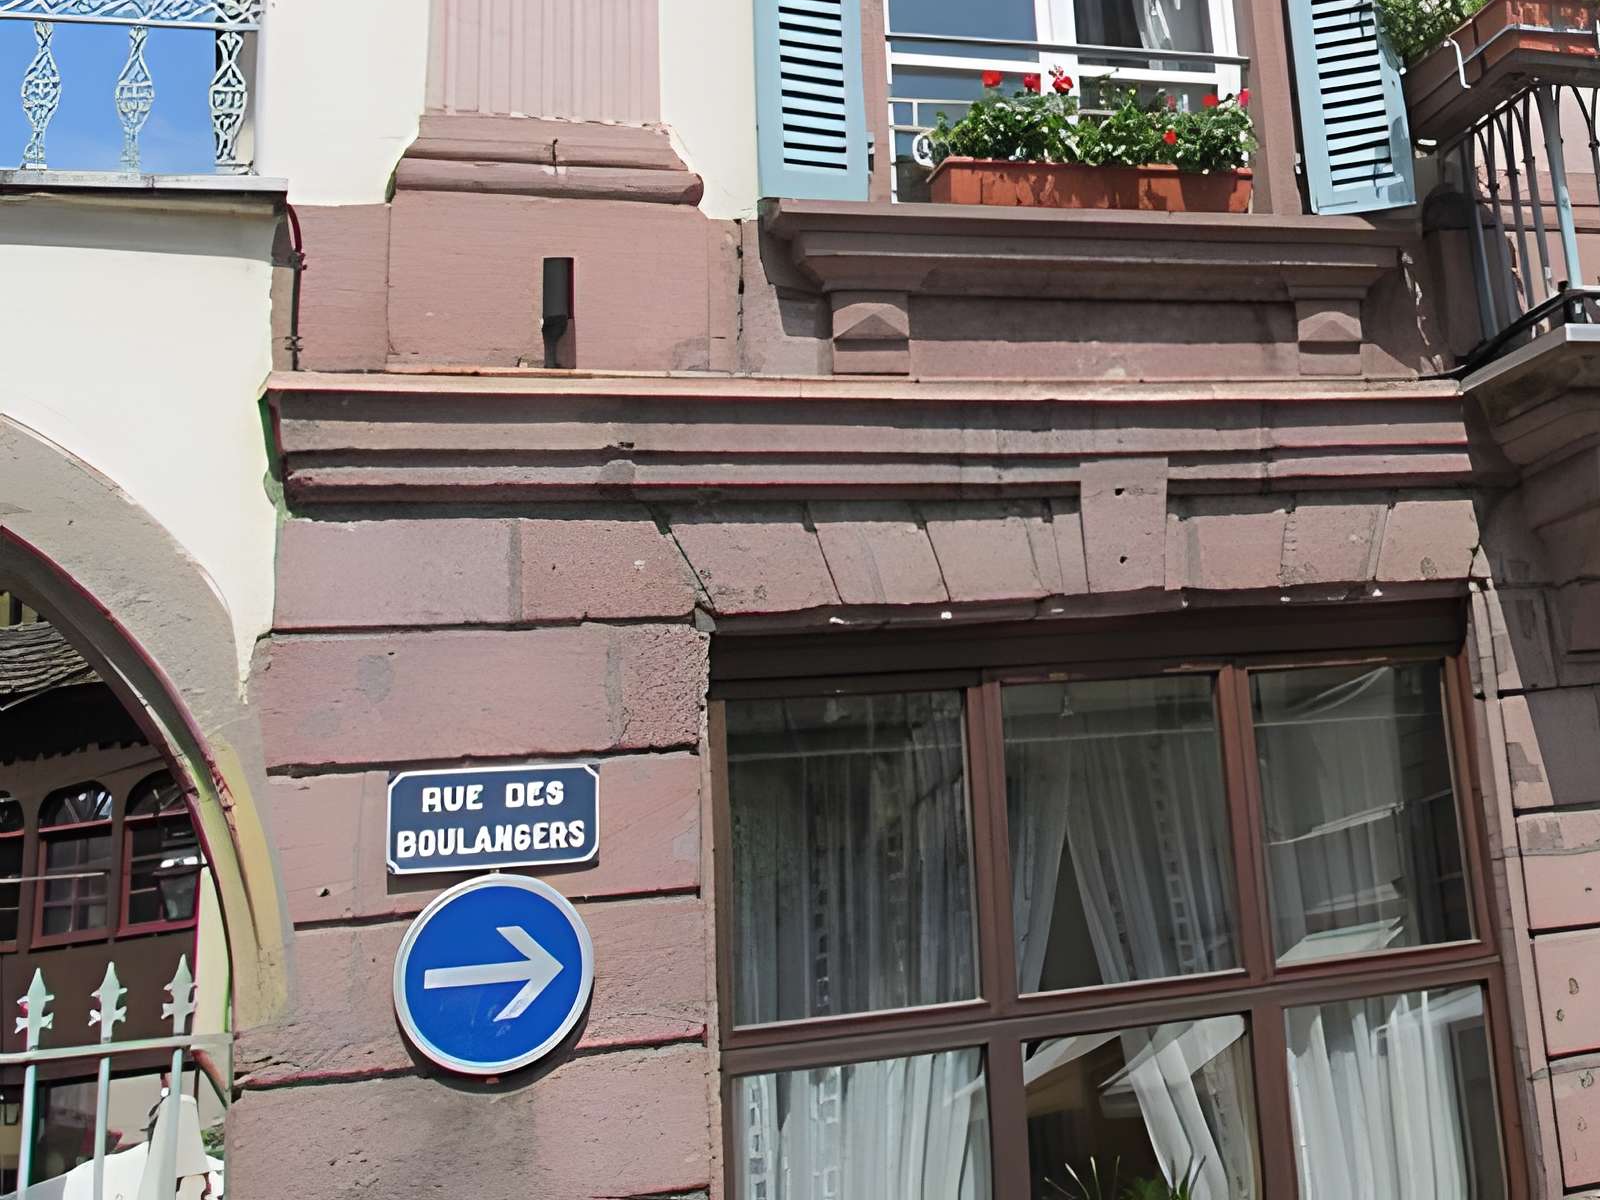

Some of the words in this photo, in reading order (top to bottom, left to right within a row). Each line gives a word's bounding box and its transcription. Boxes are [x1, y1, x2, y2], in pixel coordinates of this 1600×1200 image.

[422, 784, 483, 813] RUE
[505, 781, 564, 808] DES
[397, 820, 585, 858] BOULANGERS
